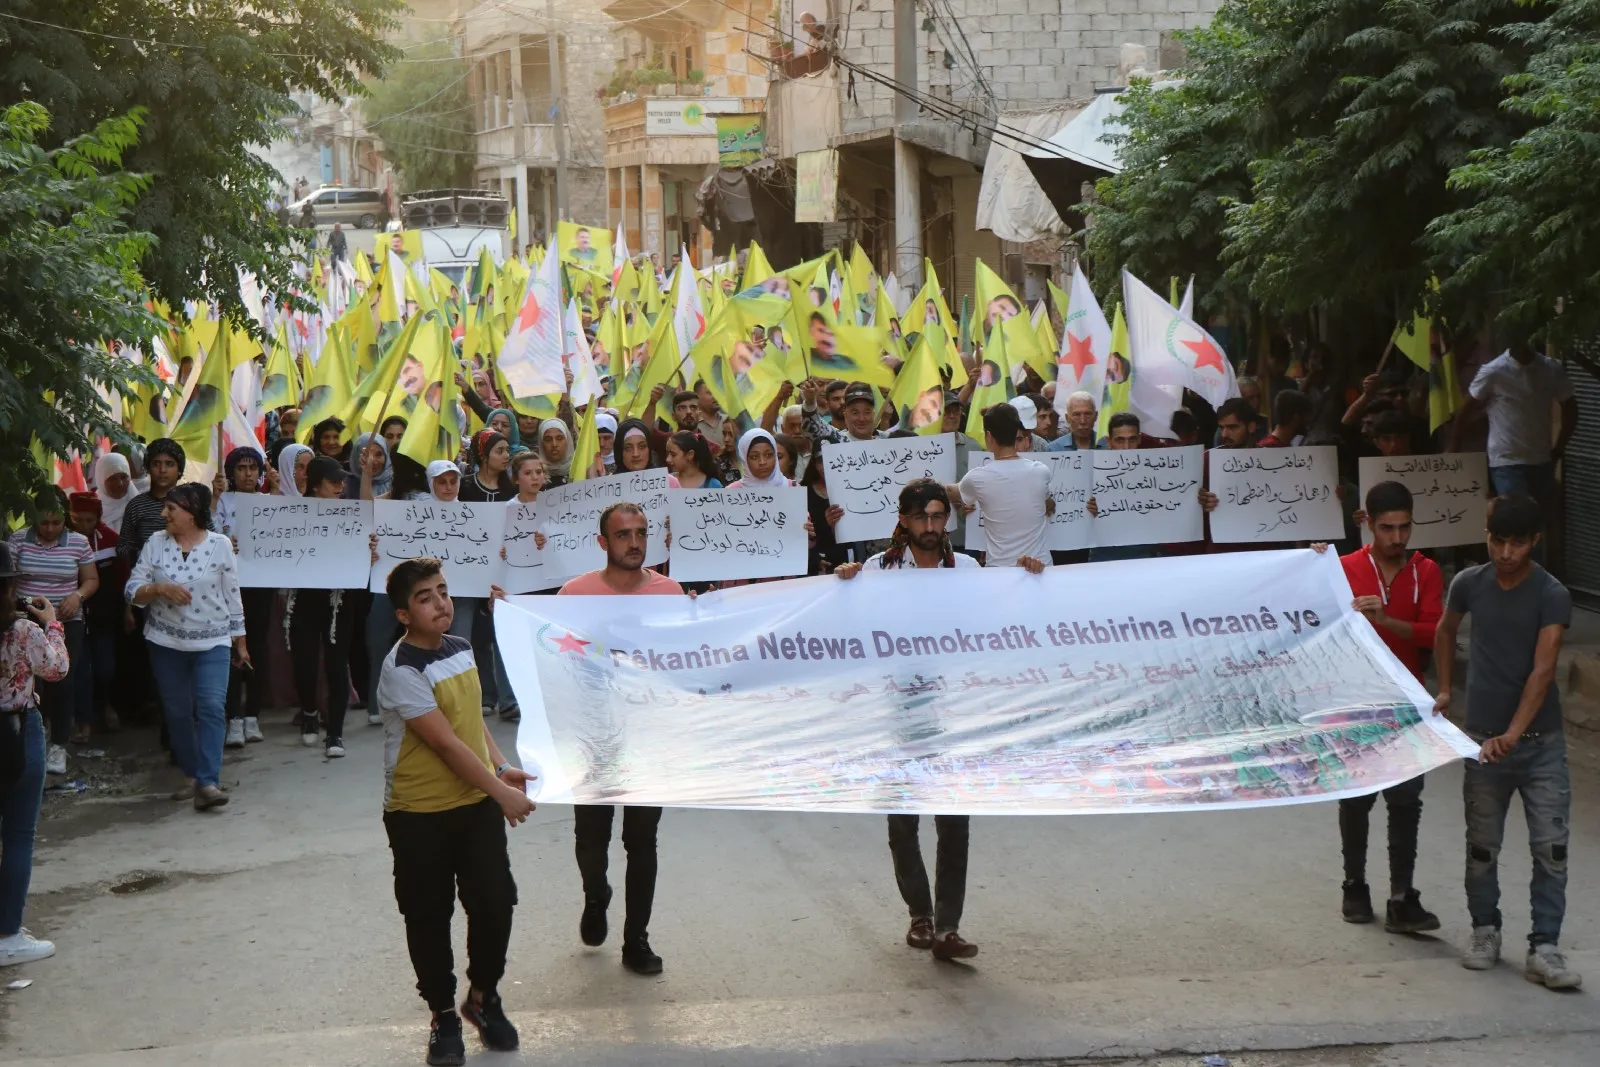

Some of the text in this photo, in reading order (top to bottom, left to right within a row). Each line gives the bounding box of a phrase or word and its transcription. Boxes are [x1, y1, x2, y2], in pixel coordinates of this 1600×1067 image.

[1093, 454, 1141, 471] لوزان
[1222, 456, 1255, 473] لوزان
[1126, 476, 1157, 494] الشعب
[684, 492, 725, 508] الشعوب
[751, 492, 774, 503] وحدة
[1165, 500, 1181, 511] من
[405, 504, 435, 523] المرأة
[1130, 499, 1164, 515] حقوقه
[728, 510, 771, 532] الجواب
[773, 511, 787, 529] هي
[466, 528, 489, 546] في
[678, 532, 733, 553] لوزان
[756, 631, 866, 661] Netewa
[871, 624, 1042, 658] Demokratîk
[1046, 616, 1177, 646] têkbirina
[1180, 606, 1278, 637] lozanê
[1283, 609, 1321, 634] ye
[1143, 657, 1199, 685] نهج
